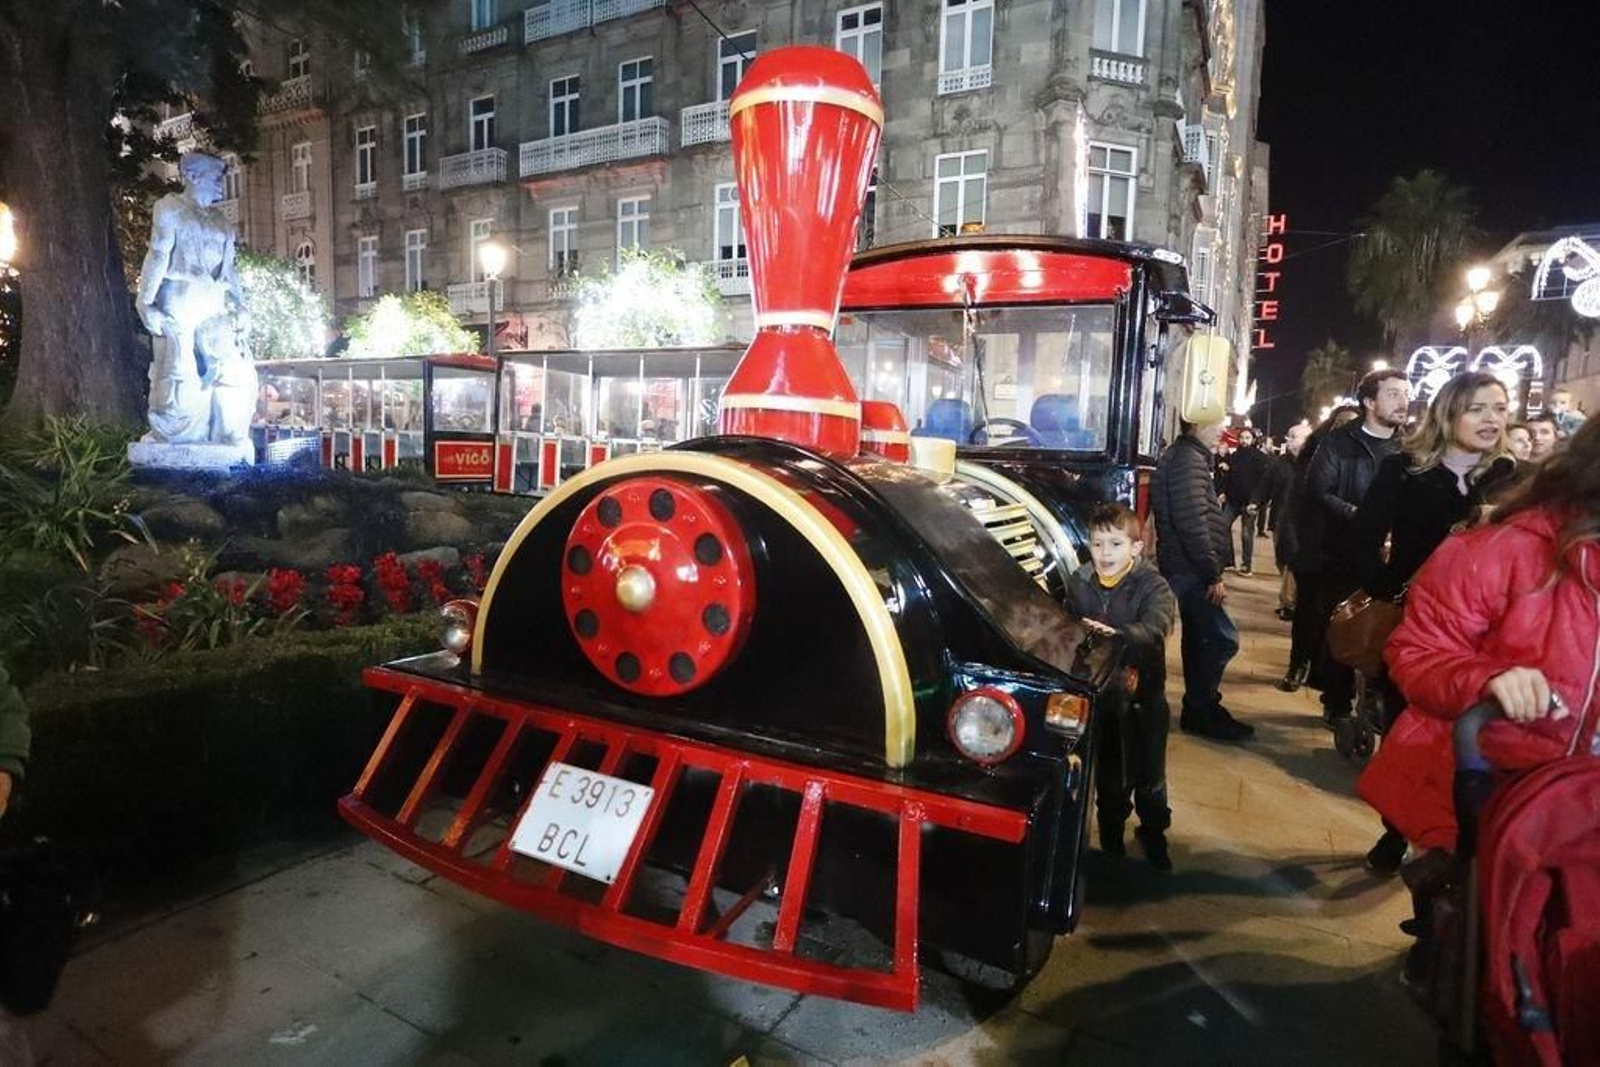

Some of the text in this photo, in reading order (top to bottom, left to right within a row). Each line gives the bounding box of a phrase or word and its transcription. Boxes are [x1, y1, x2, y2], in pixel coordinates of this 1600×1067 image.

[1258, 214, 1287, 348] HOTEL
[548, 769, 637, 818] E 3913
[537, 822, 590, 868] BCL
